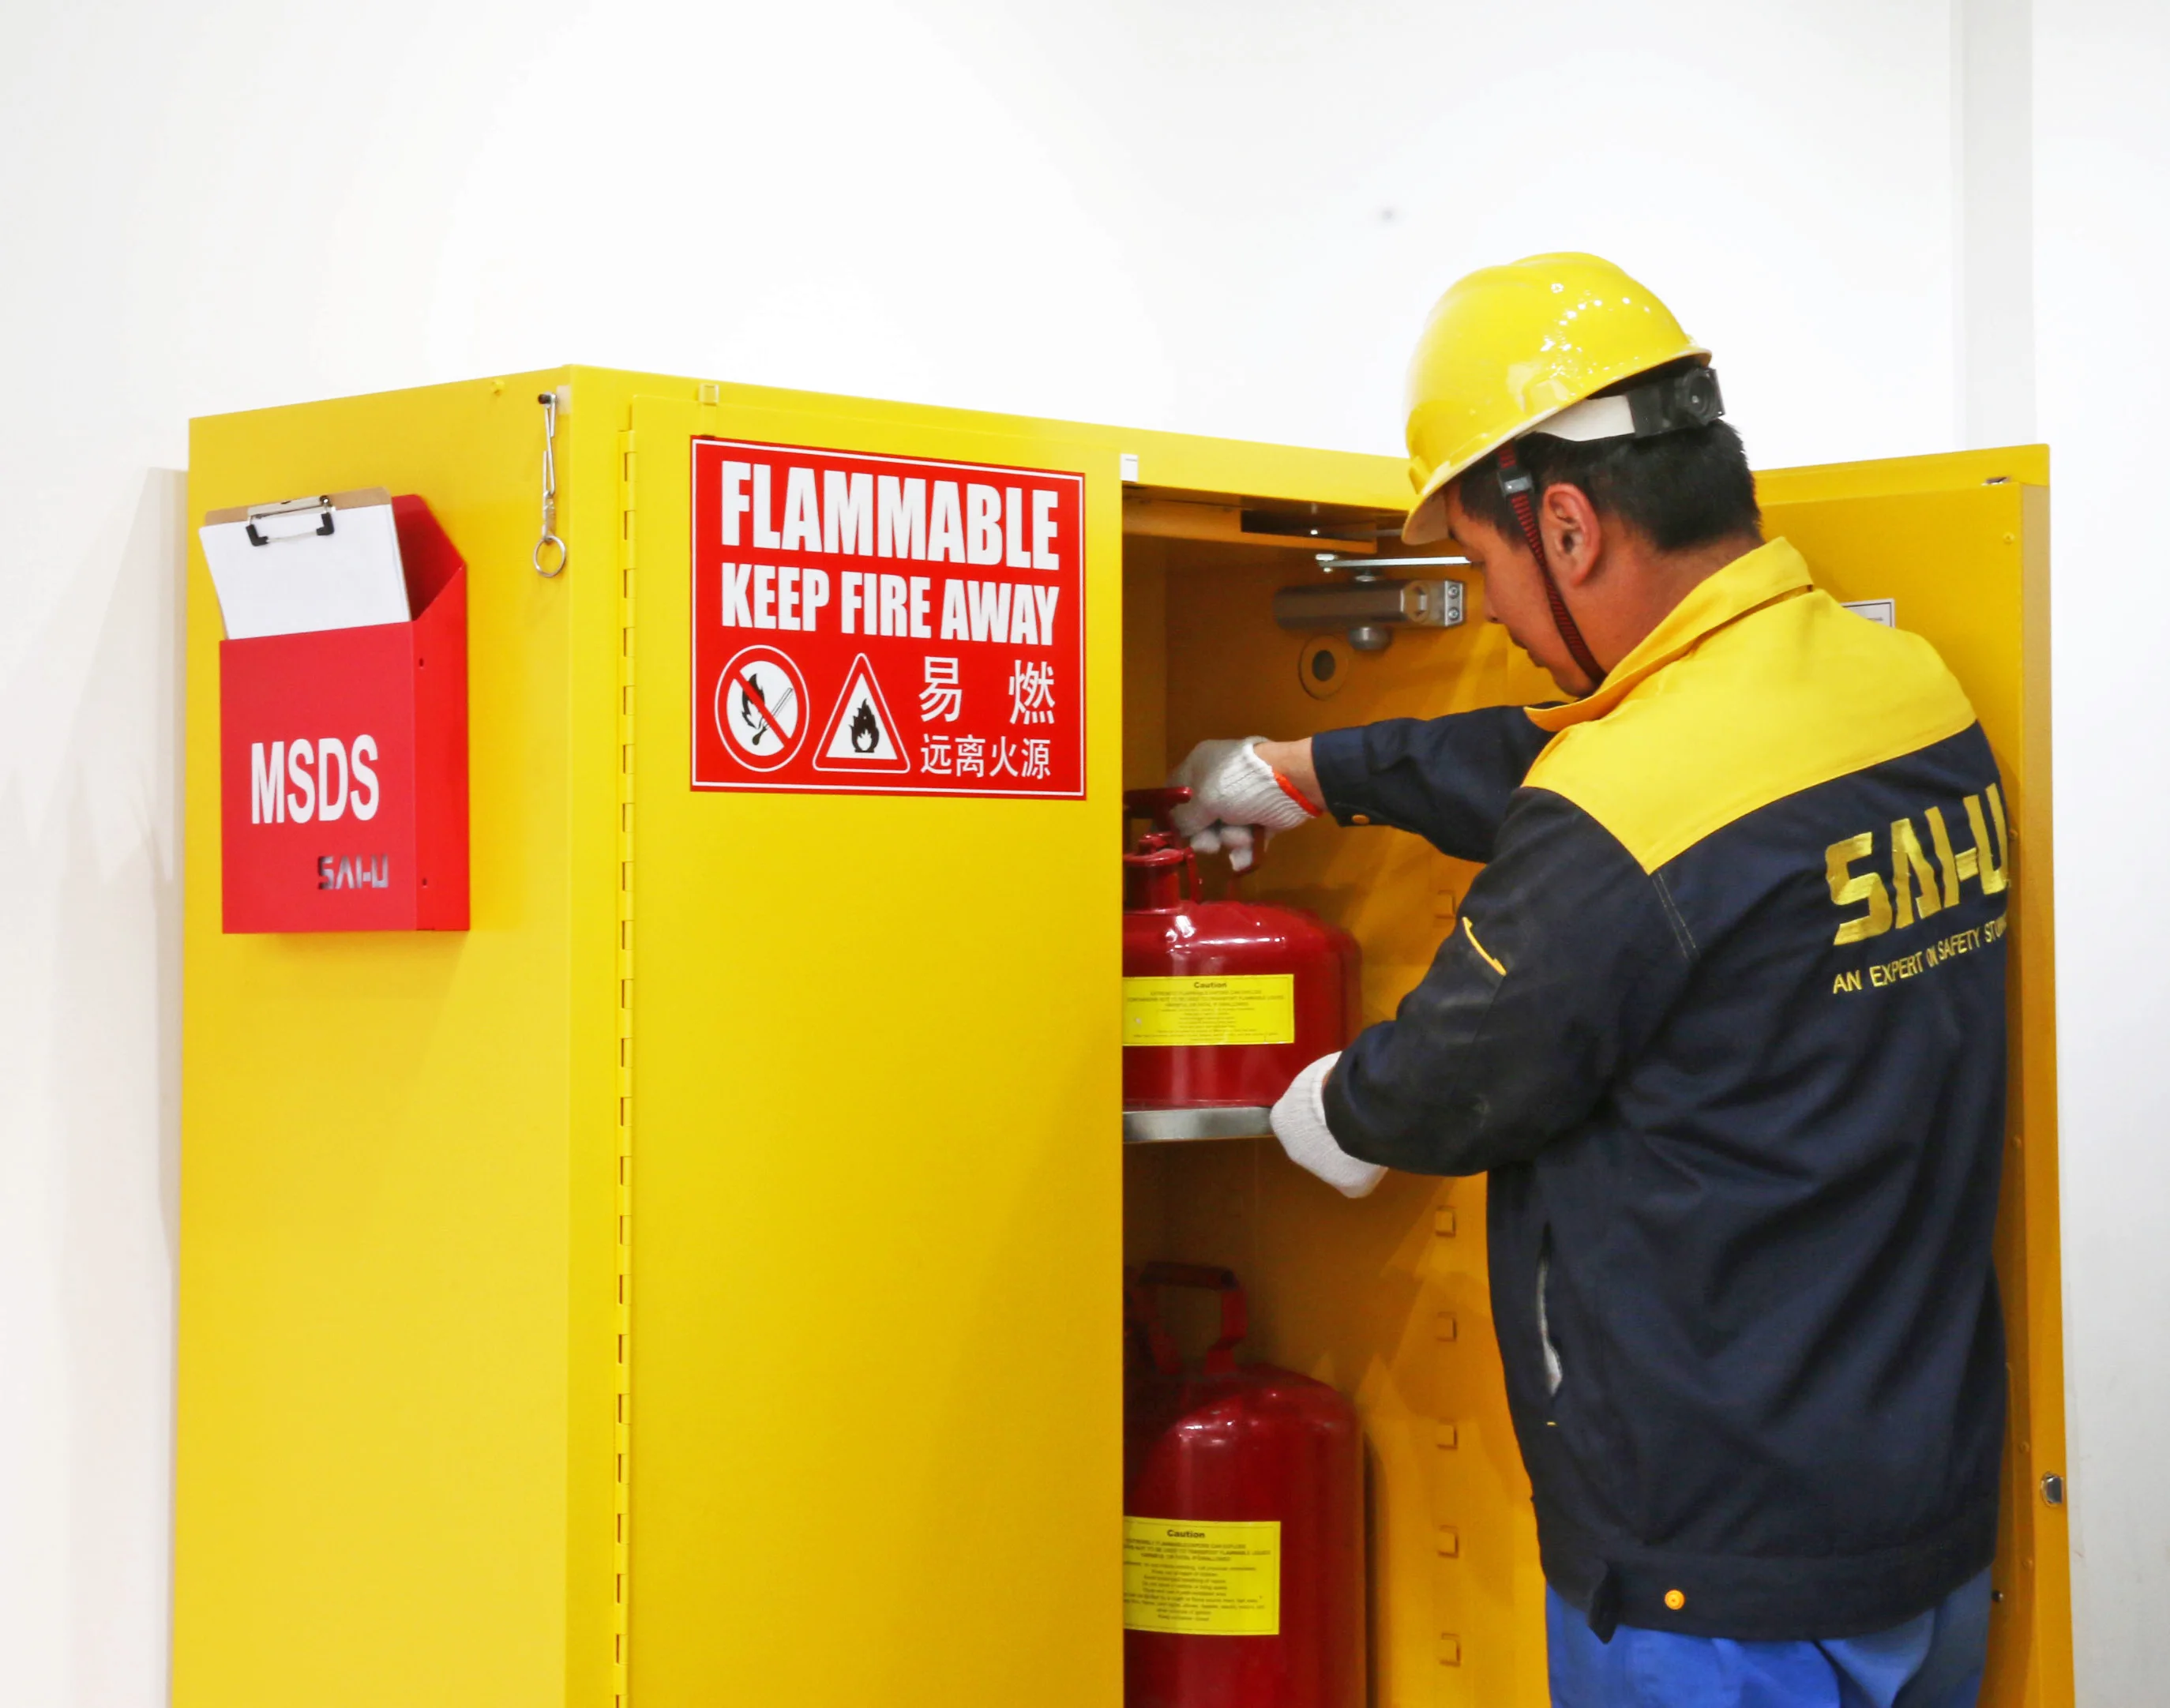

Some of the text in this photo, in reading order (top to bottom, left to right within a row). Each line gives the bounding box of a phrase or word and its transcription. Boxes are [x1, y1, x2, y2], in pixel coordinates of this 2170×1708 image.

[722, 460, 1060, 571] FLAMMABLE
[722, 562, 1060, 646] KEEP FIRE AWAY
[251, 734, 380, 824] MSDS
[920, 734, 1052, 780] 远离火源
[1833, 970, 1862, 994] AN
[1869, 951, 1924, 987] EXPERT
[1938, 927, 1980, 960] SAFETY
[1166, 1530, 1206, 1538] Caution
